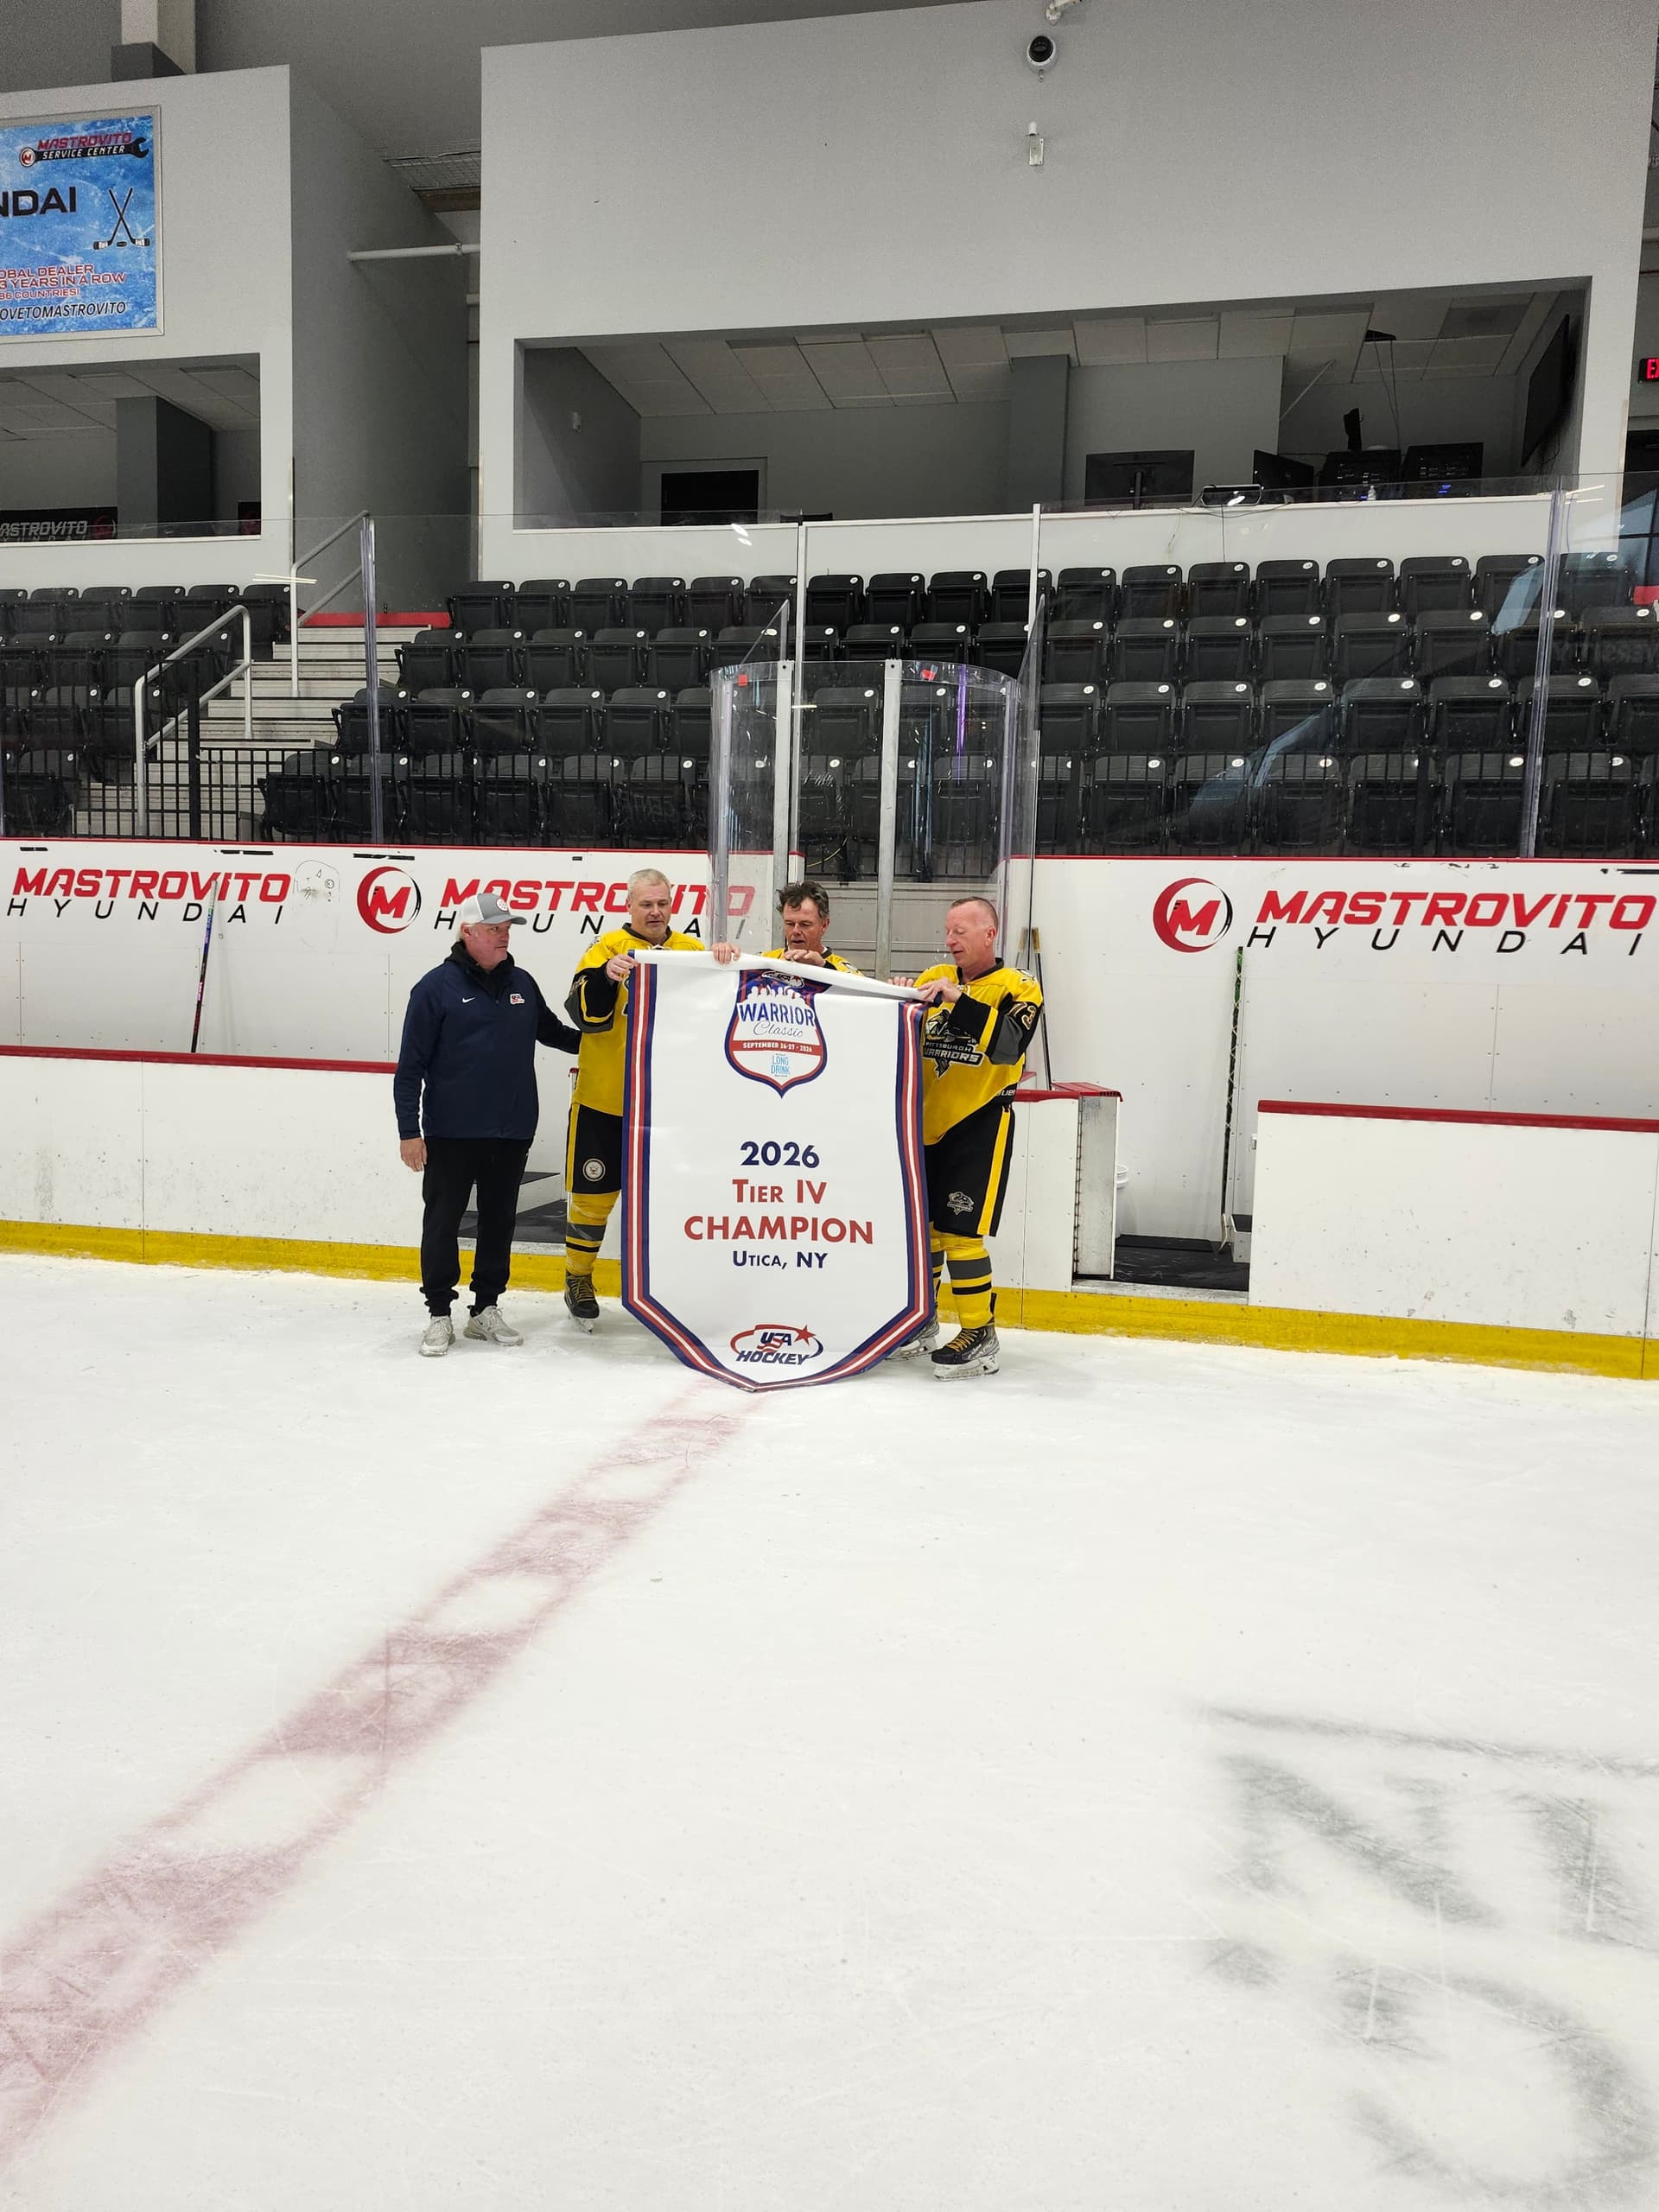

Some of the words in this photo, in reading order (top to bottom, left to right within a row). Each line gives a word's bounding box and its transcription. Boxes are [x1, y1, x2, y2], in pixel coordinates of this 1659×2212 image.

[37, 132, 132, 150] MASTROVITO
[42, 149, 82, 160] SERVICE
[87, 145, 125, 156] CENTER
[38, 264, 94, 276] DEALER
[11, 276, 58, 289] YEARS
[62, 276, 75, 286] IN
[79, 276, 88, 284] A
[92, 272, 126, 284] ROW
[12, 867, 292, 903] MASTROVITO
[7, 898, 283, 925] HYUNDAI
[1255, 890, 1657, 930] MASTROVITO
[1246, 925, 1643, 957] HYUNDAI
[739, 1002, 815, 1027] WARRIOR
[753, 1020, 804, 1038] Classic
[772, 1055, 788, 1065] LONG
[771, 1065, 790, 1075] DRINK
[740, 1141, 820, 1168] 2026
[797, 1179, 828, 1204] IV
[684, 1215, 874, 1244] CHAMPION
[797, 1251, 828, 1268] NY
[759, 1332, 792, 1348] USA
[736, 1351, 810, 1365] HOCKEY
